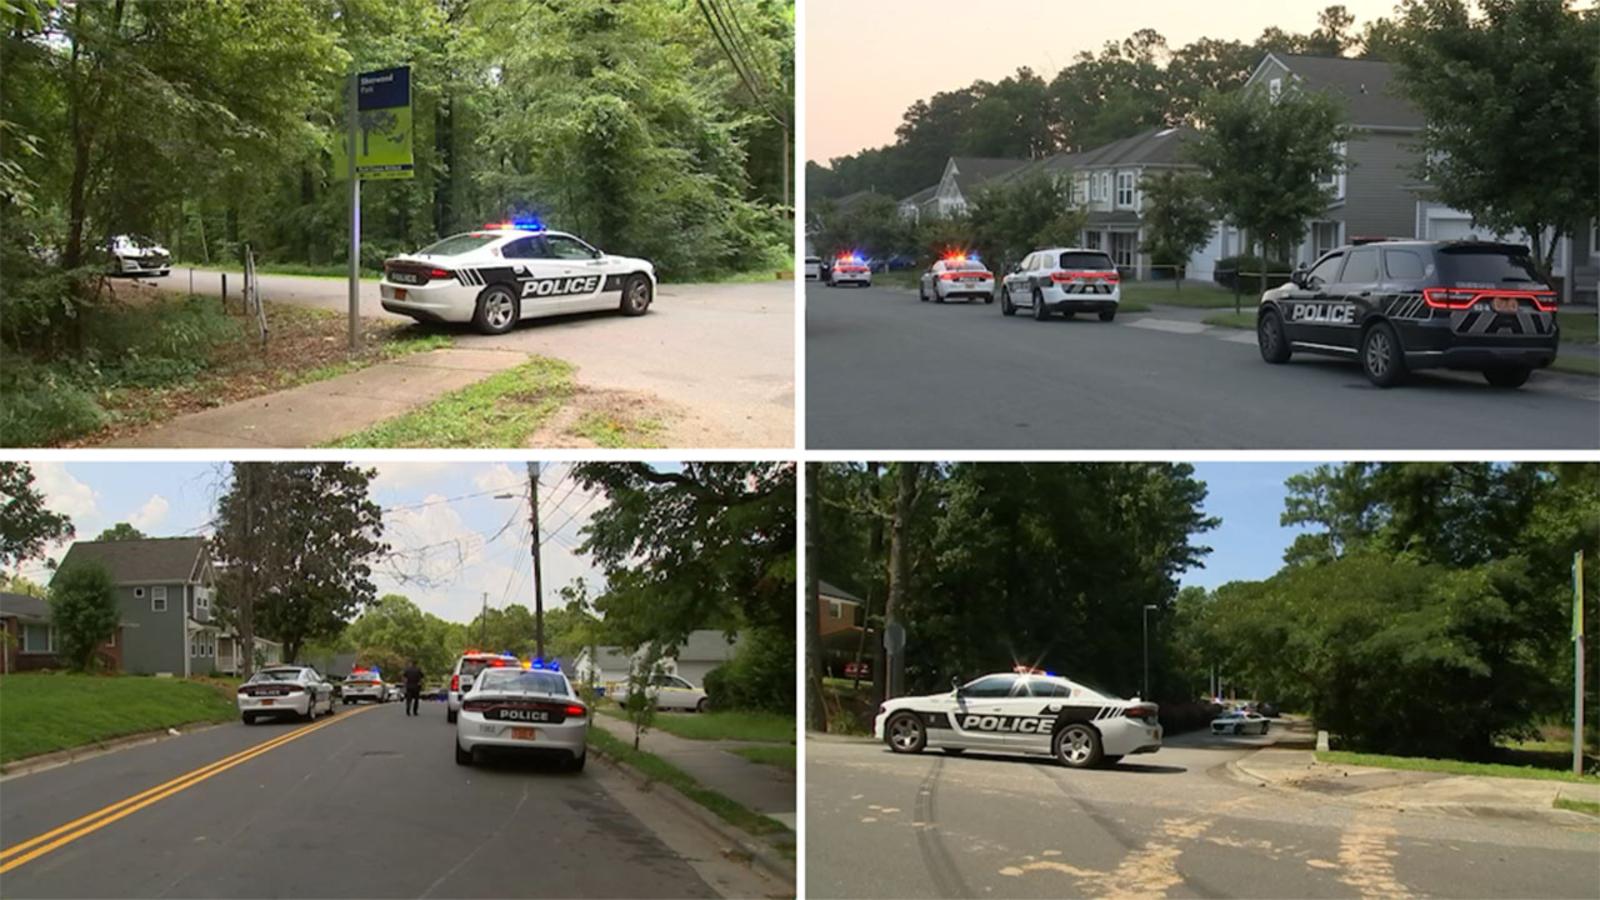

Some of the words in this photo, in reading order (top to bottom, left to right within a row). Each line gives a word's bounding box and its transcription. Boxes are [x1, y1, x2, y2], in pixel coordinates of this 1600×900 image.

[391, 272, 418, 284] POLICE
[520, 276, 598, 297] POLICE
[1292, 303, 1356, 323] POLICE
[500, 709, 550, 721] POLICE
[962, 715, 1056, 734] POLICE
